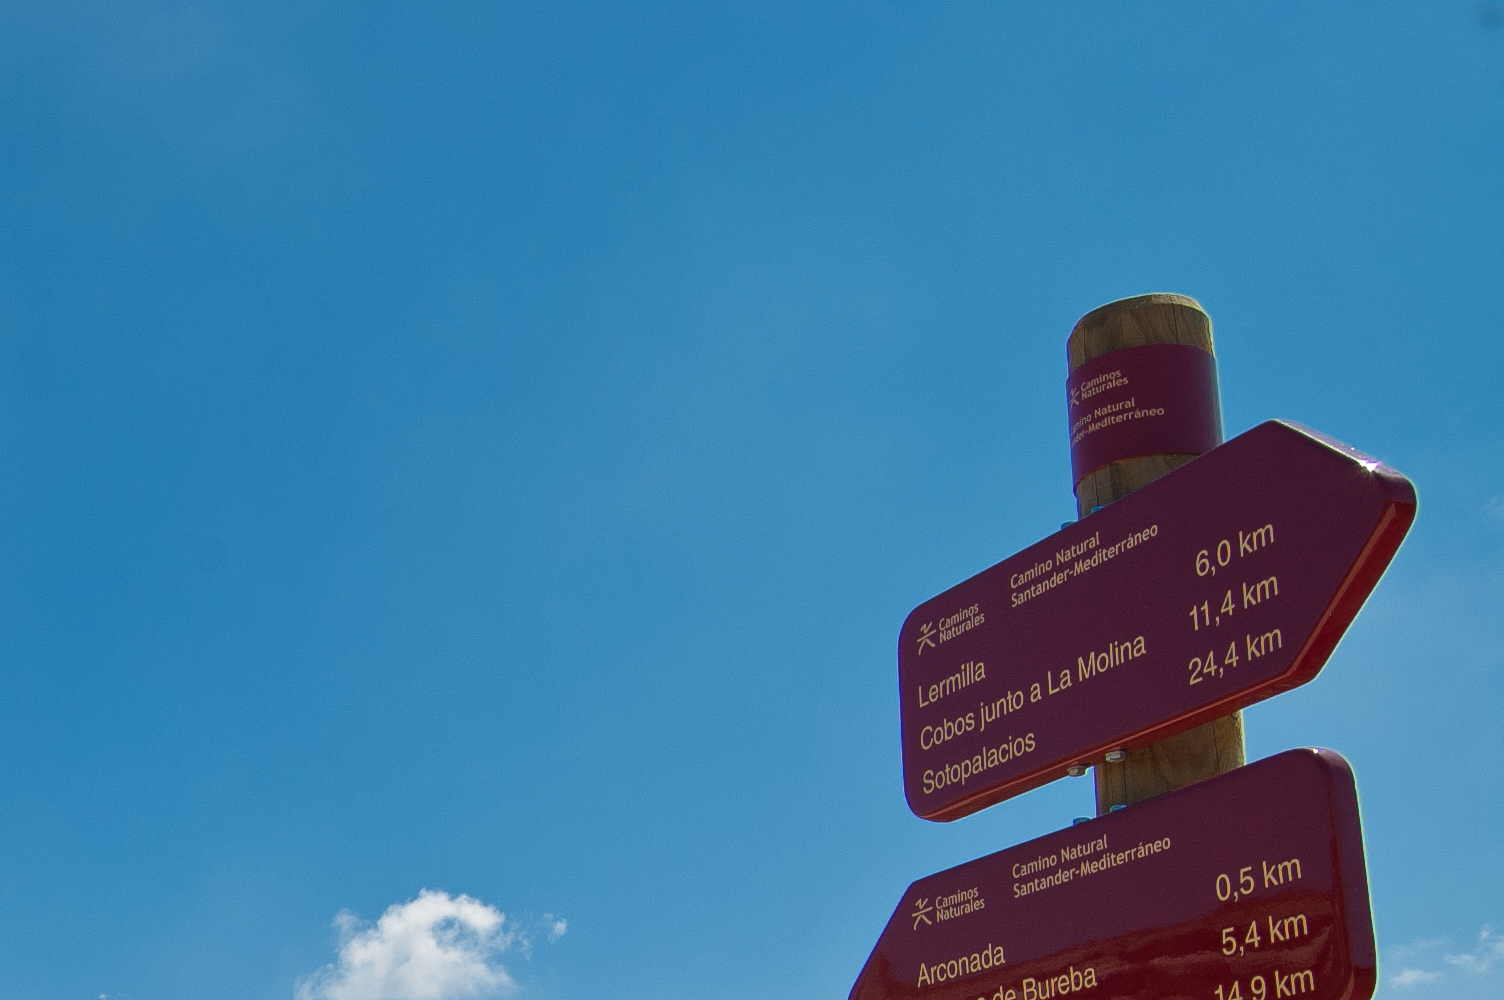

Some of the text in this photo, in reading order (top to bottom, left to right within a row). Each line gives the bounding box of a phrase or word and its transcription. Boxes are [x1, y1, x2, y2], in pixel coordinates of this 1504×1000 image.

[1080, 370, 1122, 392] Caminos
[1081, 377, 1129, 401] Naturales
[1094, 397, 1136, 419] Natural
[1010, 531, 1100, 589] Camino Natural
[1011, 524, 1158, 608] Santander-Mediterráneo
[1195, 523, 1275, 577] 6,0 km
[938, 603, 980, 632] Caminos
[1189, 575, 1279, 632] 11,4 km
[939, 612, 985, 644] Naturales
[1188, 628, 1282, 686] 24,4 km
[918, 660, 986, 709] Lermilla
[920, 634, 1147, 751] Cobos junto a La Molina
[922, 732, 1037, 795] Sotopalacios
[1012, 833, 1108, 880] Camino Natural
[1013, 837, 1171, 899] Santander-Mediterráneo
[935, 886, 979, 910] Caminos
[1215, 858, 1302, 902] 0,5 km
[936, 897, 985, 923] Naturales
[1222, 913, 1308, 957] 5,4 km
[917, 942, 1006, 988] Arconada
[1274, 969, 1315, 999] km
